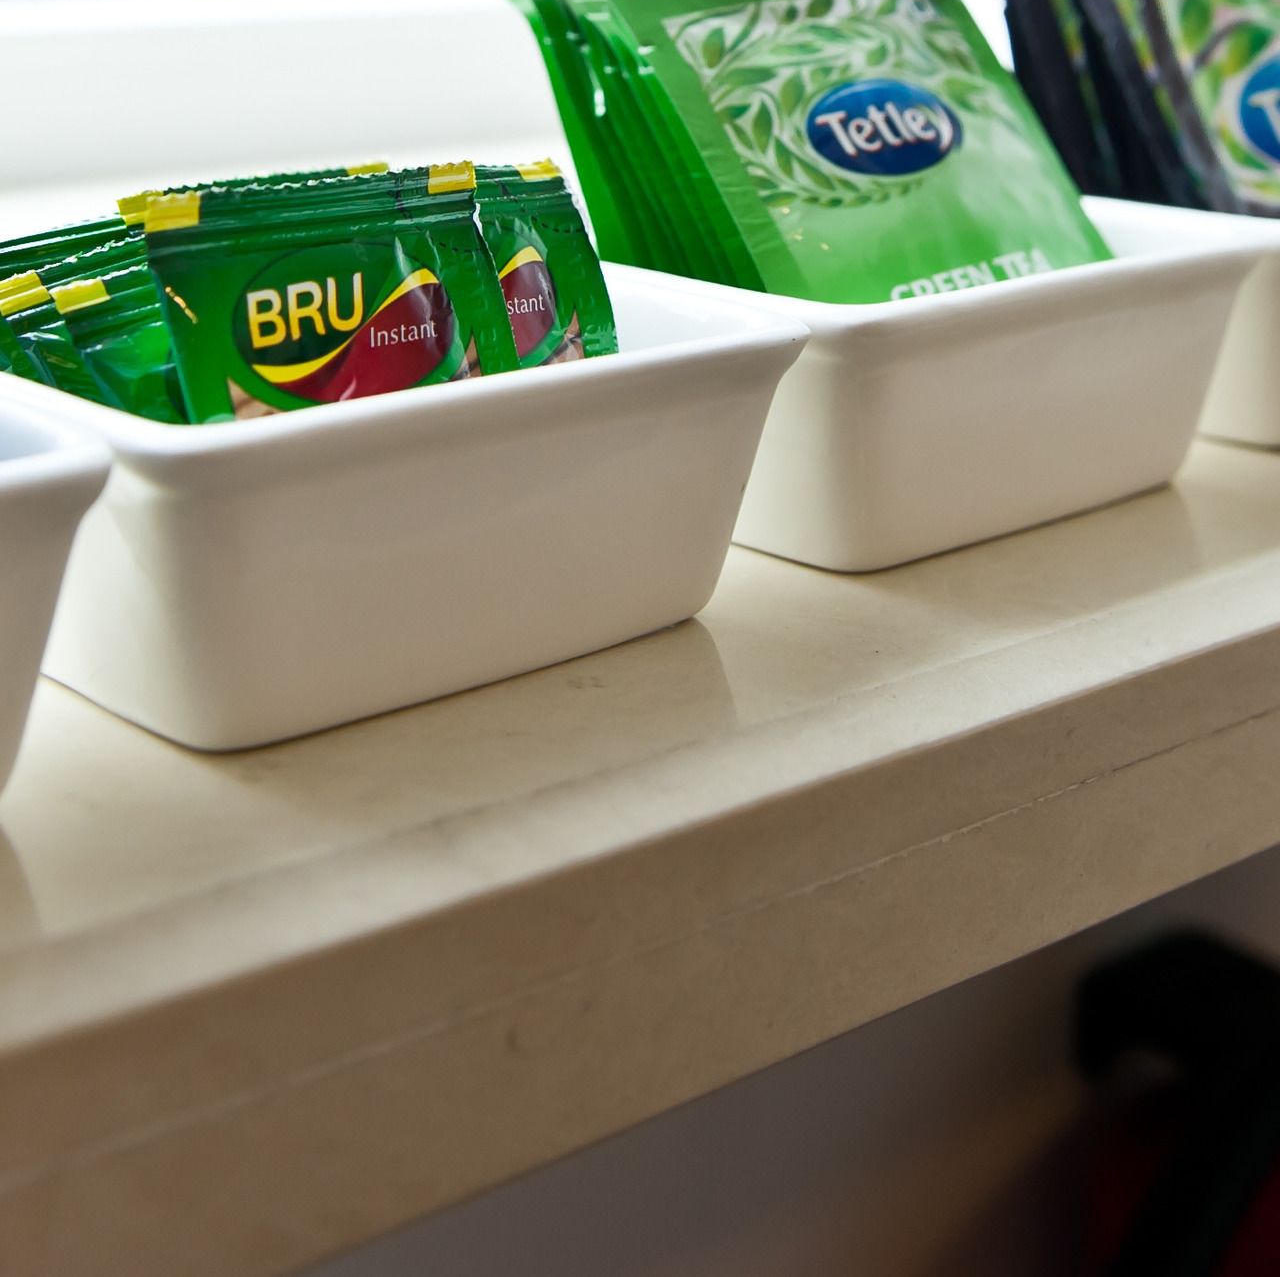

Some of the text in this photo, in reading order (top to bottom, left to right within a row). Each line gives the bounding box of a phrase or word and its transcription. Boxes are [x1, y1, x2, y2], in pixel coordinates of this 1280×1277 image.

[815, 100, 954, 157] Tetley
[246, 271, 365, 350] BRU
[506, 293, 546, 316] stant
[370, 319, 438, 349] Instant
